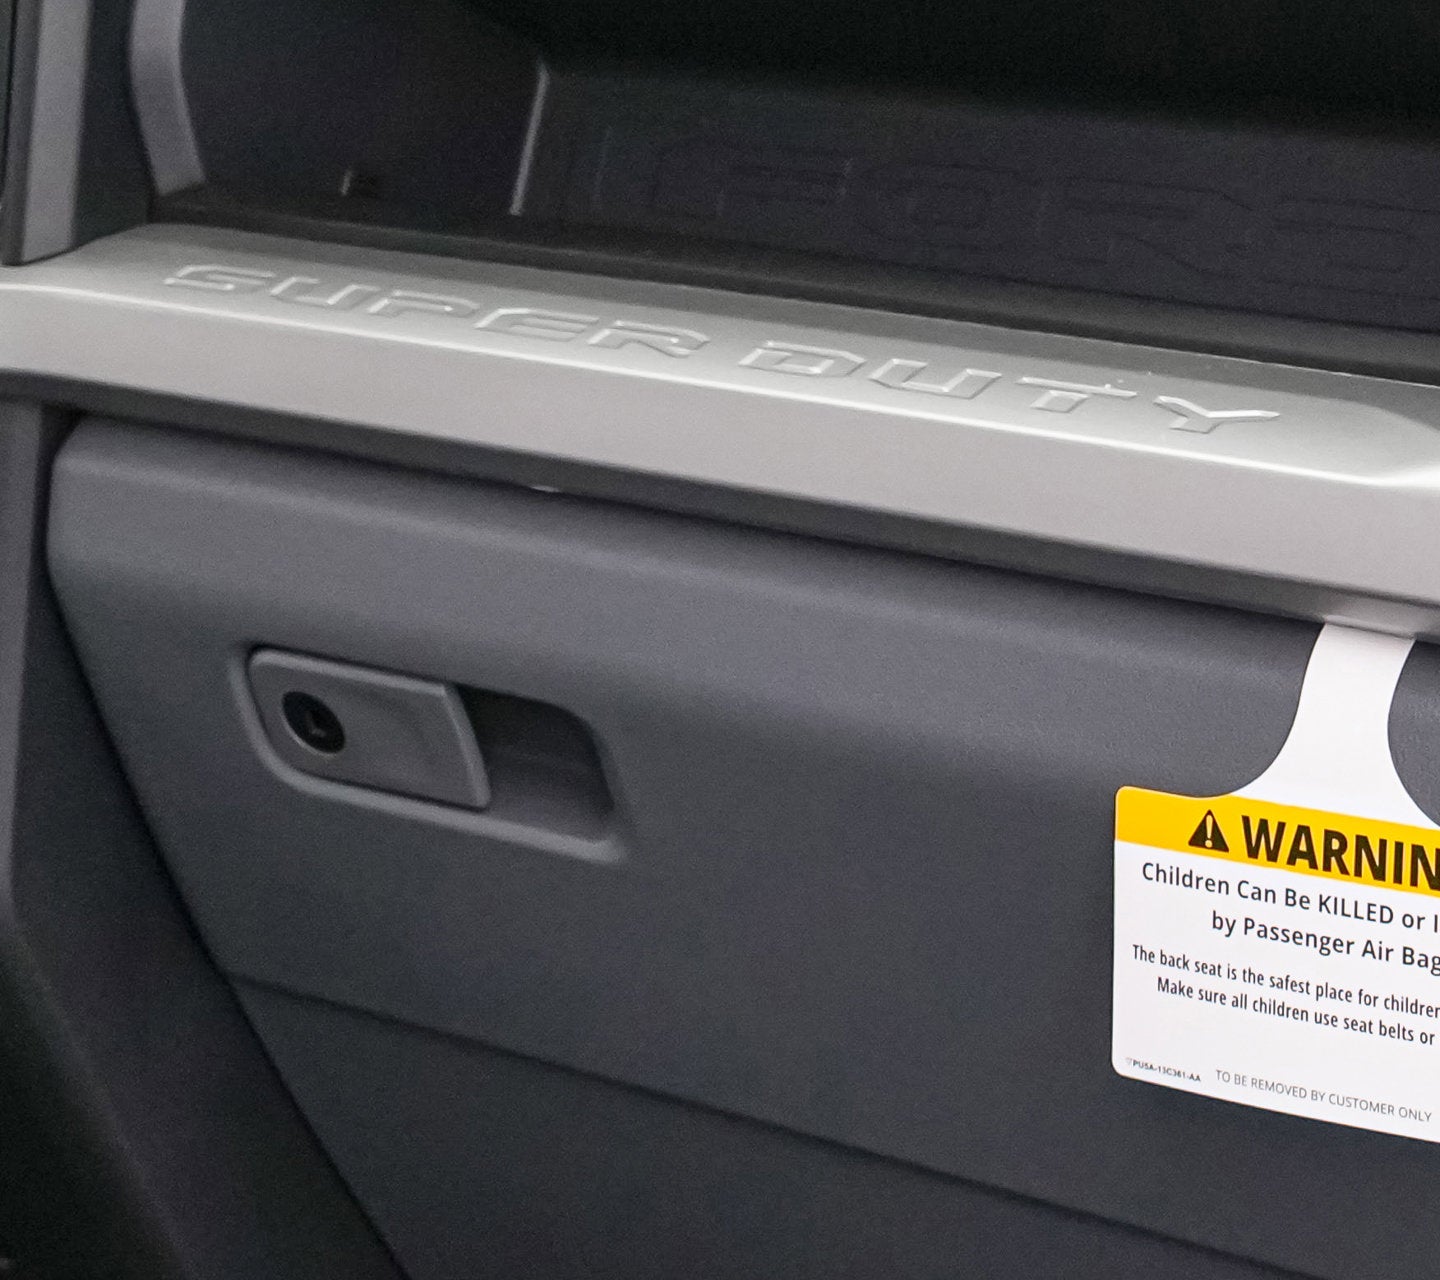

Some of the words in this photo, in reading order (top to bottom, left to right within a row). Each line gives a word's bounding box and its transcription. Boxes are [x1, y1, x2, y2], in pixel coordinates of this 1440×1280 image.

[164, 264, 710, 359] SUPER
[738, 340, 1280, 435] DUTY
[1142, 862, 1229, 895] Children
[1238, 880, 1276, 904] Can
[1285, 888, 1310, 910] Be
[1319, 894, 1393, 924] KILLED
[1402, 913, 1425, 930] or
[1212, 910, 1236, 938] by
[1244, 917, 1355, 956] Passenger
[1361, 939, 1394, 962] Air
[1133, 944, 1155, 963] The
[1160, 949, 1190, 971] back
[1195, 961, 1222, 978] seat
[1227, 963, 1237, 980] is
[1243, 967, 1264, 986] the
[1270, 975, 1310, 995] safest
[1316, 982, 1352, 1003] place
[1358, 989, 1379, 1007] for
[1158, 976, 1193, 998] Make
[1198, 989, 1226, 1005] sure
[1232, 993, 1247, 1010] all
[1253, 997, 1308, 1022] children
[1314, 1012, 1338, 1027] use
[1344, 1018, 1373, 1034] seat
[1379, 1019, 1414, 1041] belts
[1420, 1032, 1435, 1045] or
[1216, 1069, 1230, 1083] TO
[1234, 1073, 1247, 1087] BE
[1251, 1078, 1307, 1098] REMOVED
[1311, 1090, 1326, 1101] BY
[1329, 1094, 1394, 1116] CUSTOMER
[1399, 1107, 1432, 1122] ONLY
